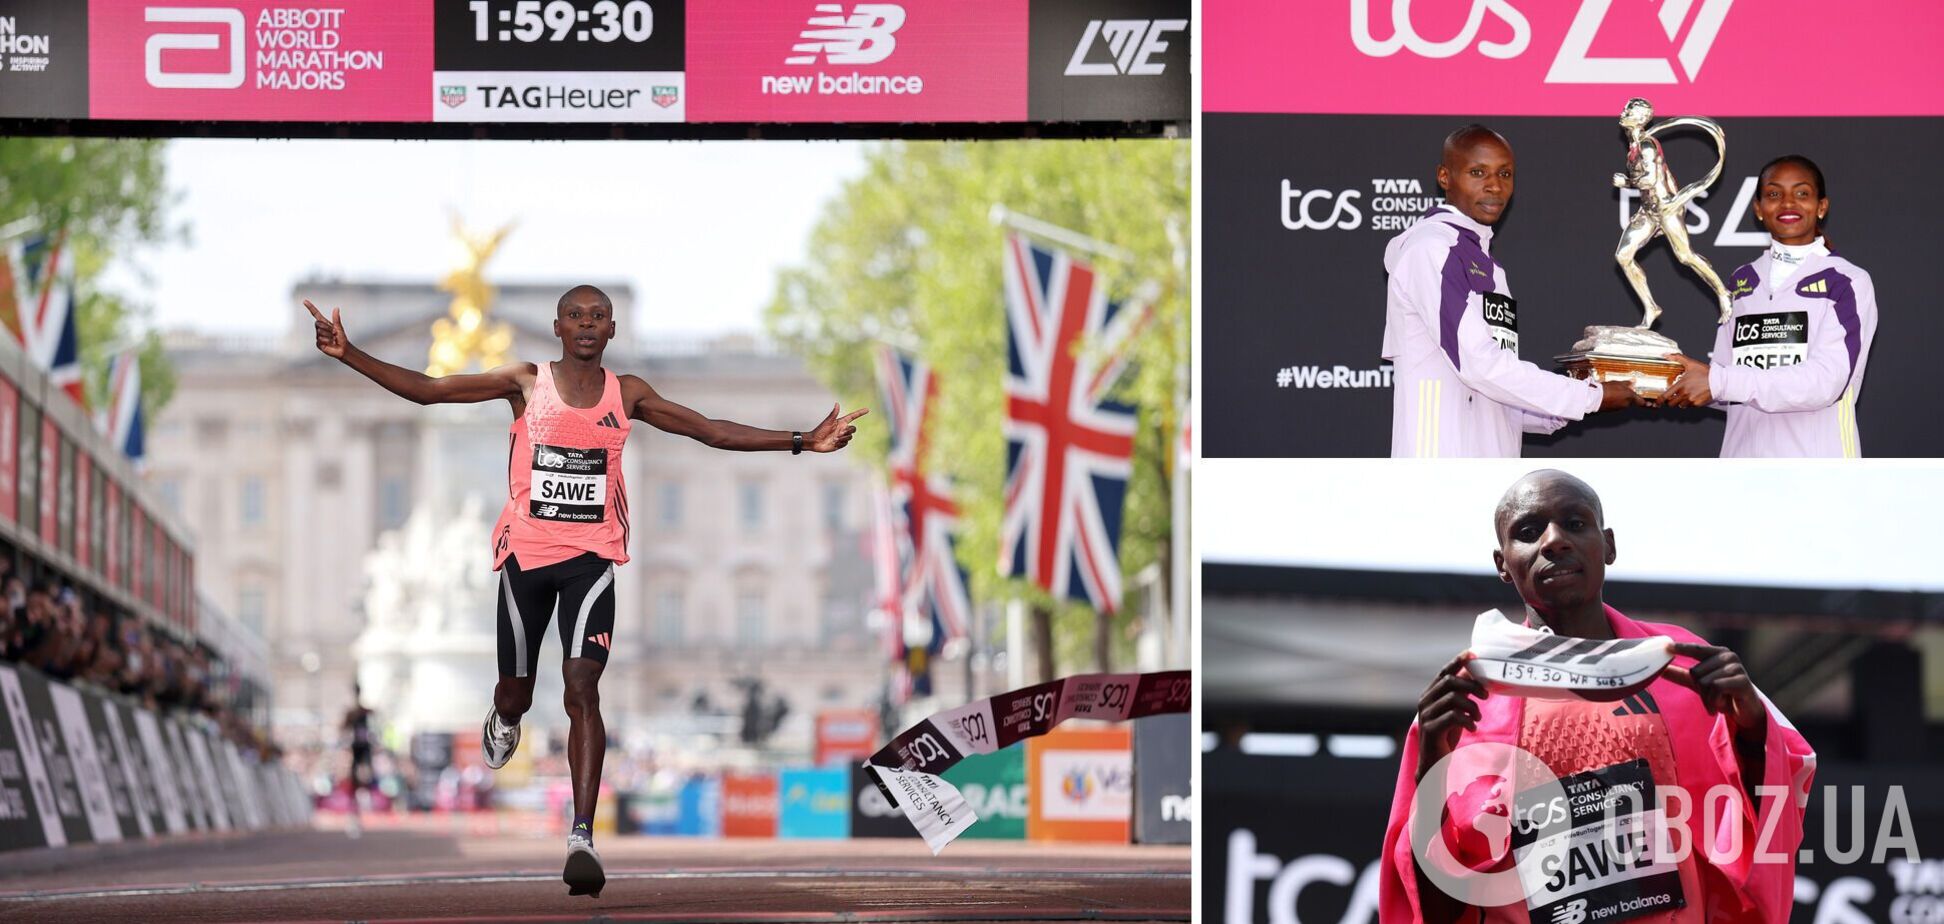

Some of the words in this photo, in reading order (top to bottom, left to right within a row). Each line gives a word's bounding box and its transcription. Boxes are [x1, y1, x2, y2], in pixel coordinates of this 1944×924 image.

[256, 9, 345, 28] ABBOTT
[469, 0, 654, 42] 1:59:30
[256, 30, 340, 49] WORLD
[256, 51, 383, 70] MARATHON
[256, 71, 346, 90] MAJORS
[762, 73, 813, 95] new
[818, 72, 923, 95] balance
[1372, 179, 1422, 194] TATA
[1281, 178, 1362, 231] tcs
[1485, 298, 1504, 321] tcs
[1736, 322, 1760, 341] tcs
[1761, 324, 1804, 332] CONSULTANCY
[541, 480, 597, 501] SAWE
[558, 512, 572, 520] new
[573, 511, 598, 520] balance
[1099, 684, 1130, 713] tcs
[908, 732, 950, 768] tcs
[896, 775, 926, 811] SERVICES
[1568, 778, 1601, 794] TATA
[1569, 780, 1645, 806] CONSULTANCY
[1514, 796, 1567, 835] tcs
[1573, 797, 1624, 818] SERVICES
[1541, 830, 1653, 893] SAWE
[1591, 904, 1619, 920] new
[1621, 892, 1671, 913] balance
